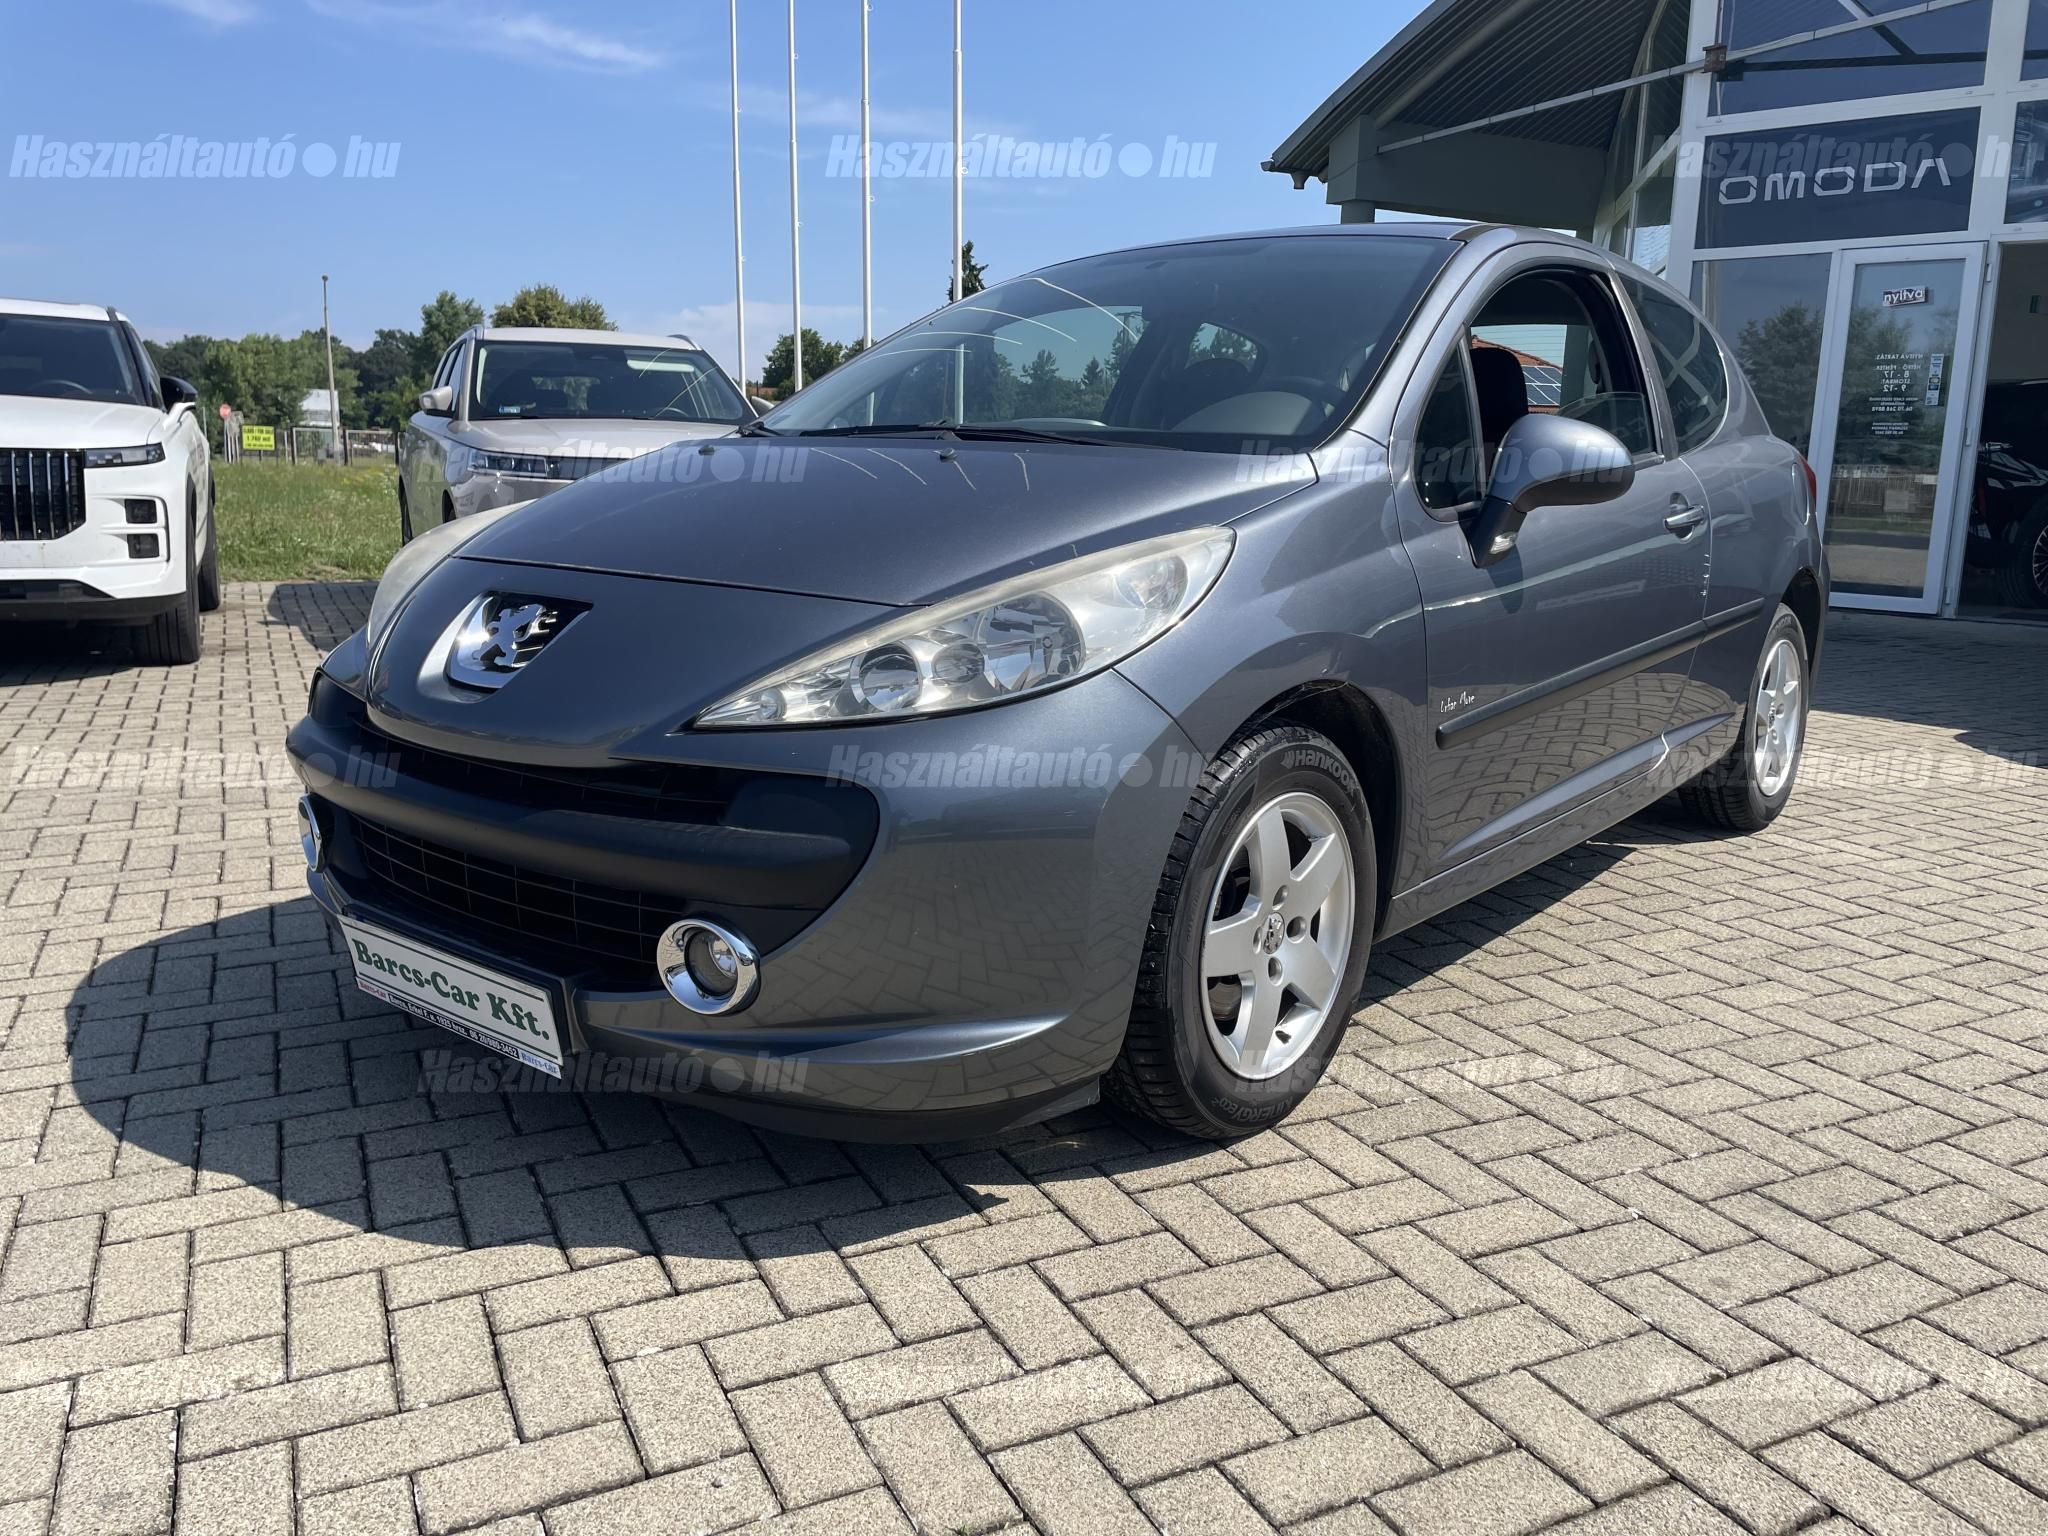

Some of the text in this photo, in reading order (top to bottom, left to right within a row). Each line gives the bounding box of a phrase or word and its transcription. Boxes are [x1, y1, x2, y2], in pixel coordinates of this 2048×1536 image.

[1719, 157, 1951, 205] OMODA
[1884, 289, 1923, 304] nyitva
[352, 938, 549, 1040] Barcs-Car Kft.
